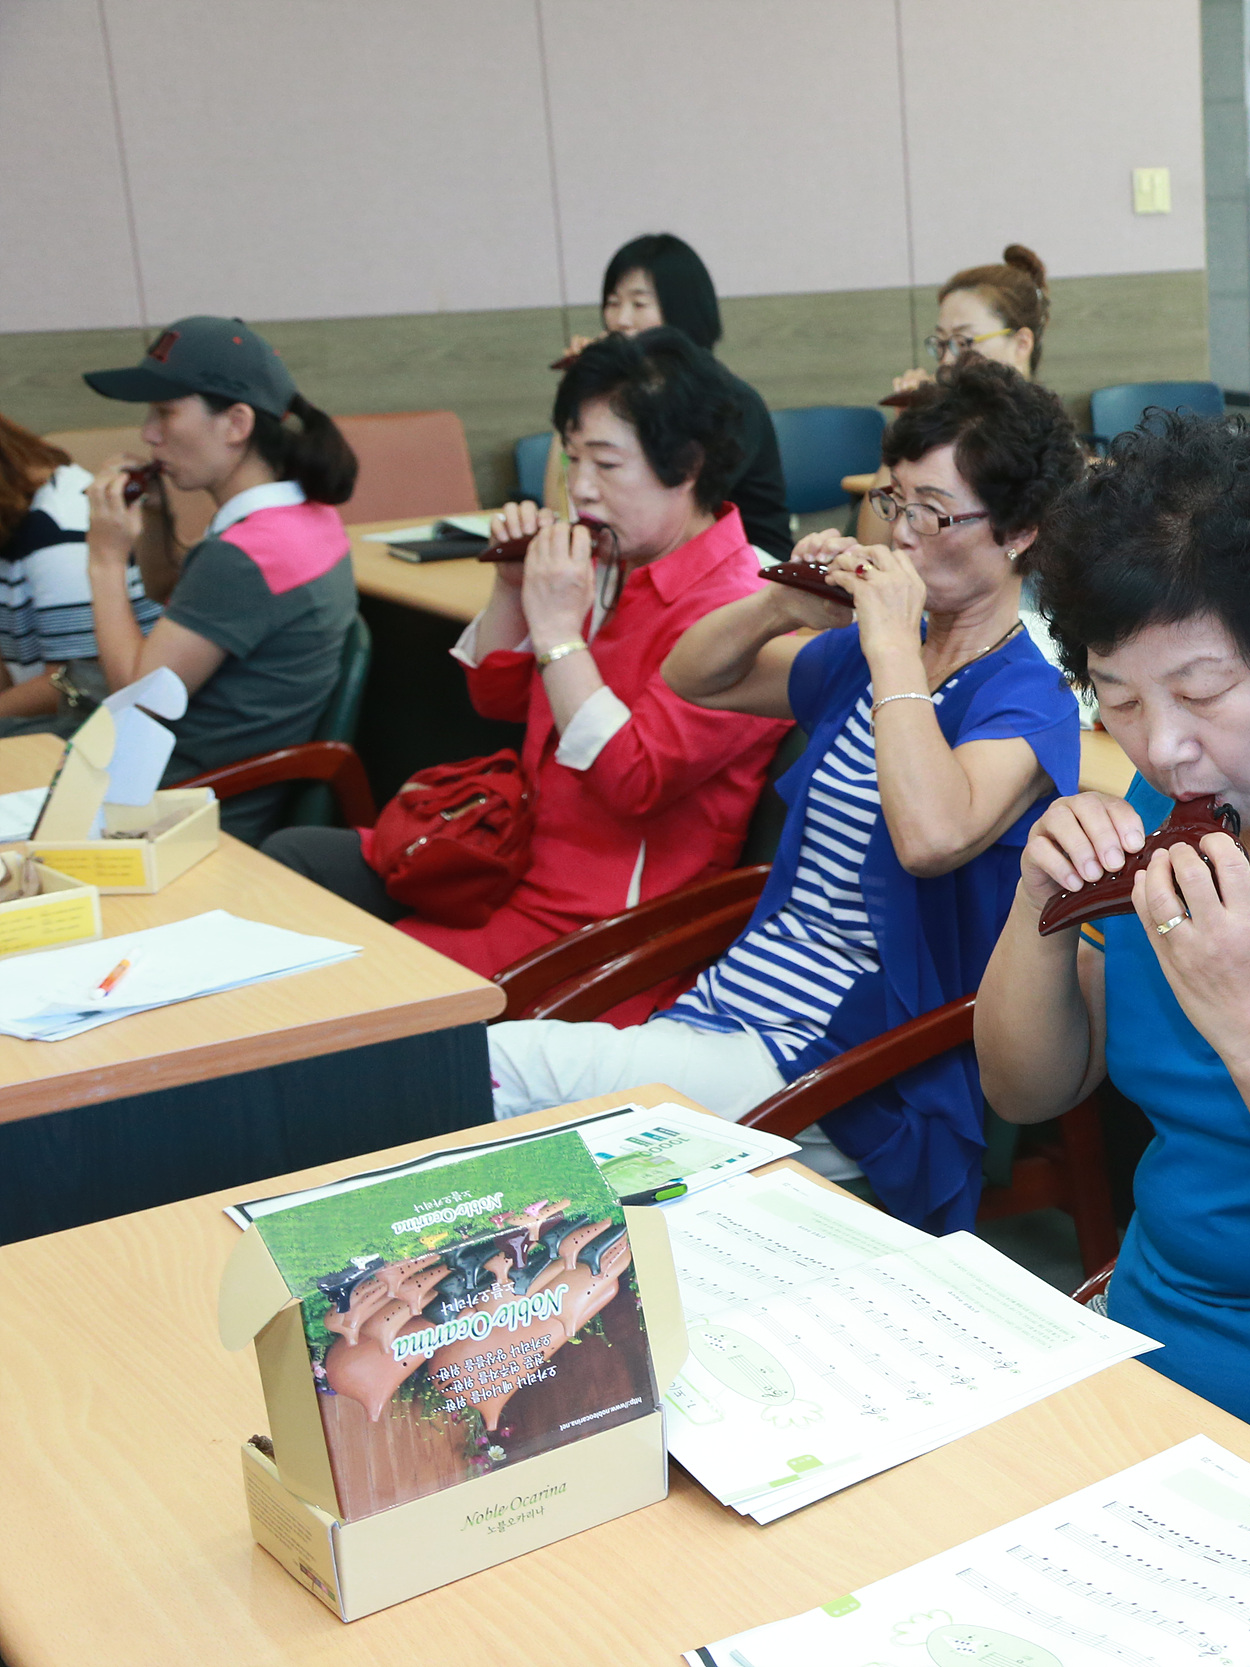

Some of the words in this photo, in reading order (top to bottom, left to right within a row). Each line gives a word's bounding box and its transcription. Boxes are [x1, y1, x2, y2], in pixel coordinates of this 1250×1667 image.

[638, 1136, 691, 1158] 10000
[413, 1190, 473, 1214] 노블오카리나
[456, 1192, 504, 1218] Noble
[391, 1207, 457, 1235] Ocarina
[440, 1281, 516, 1316] 노블오카리나
[492, 1283, 569, 1332] Noble
[391, 1311, 493, 1361] Ocarina
[509, 1334, 552, 1358] 오카리나
[464, 1348, 507, 1373] 앙상블을
[478, 1360, 521, 1385] 연주자를
[522, 1352, 545, 1370] 전문
[516, 1365, 557, 1389] 오카리나
[470, 1380, 514, 1405] 매니아를
[558, 1395, 643, 1431] http://www.nobleocarina.net
[460, 1503, 508, 1532] Noble
[509, 1482, 568, 1511] Ocarina
[486, 1505, 545, 1535] 노블오카리나
